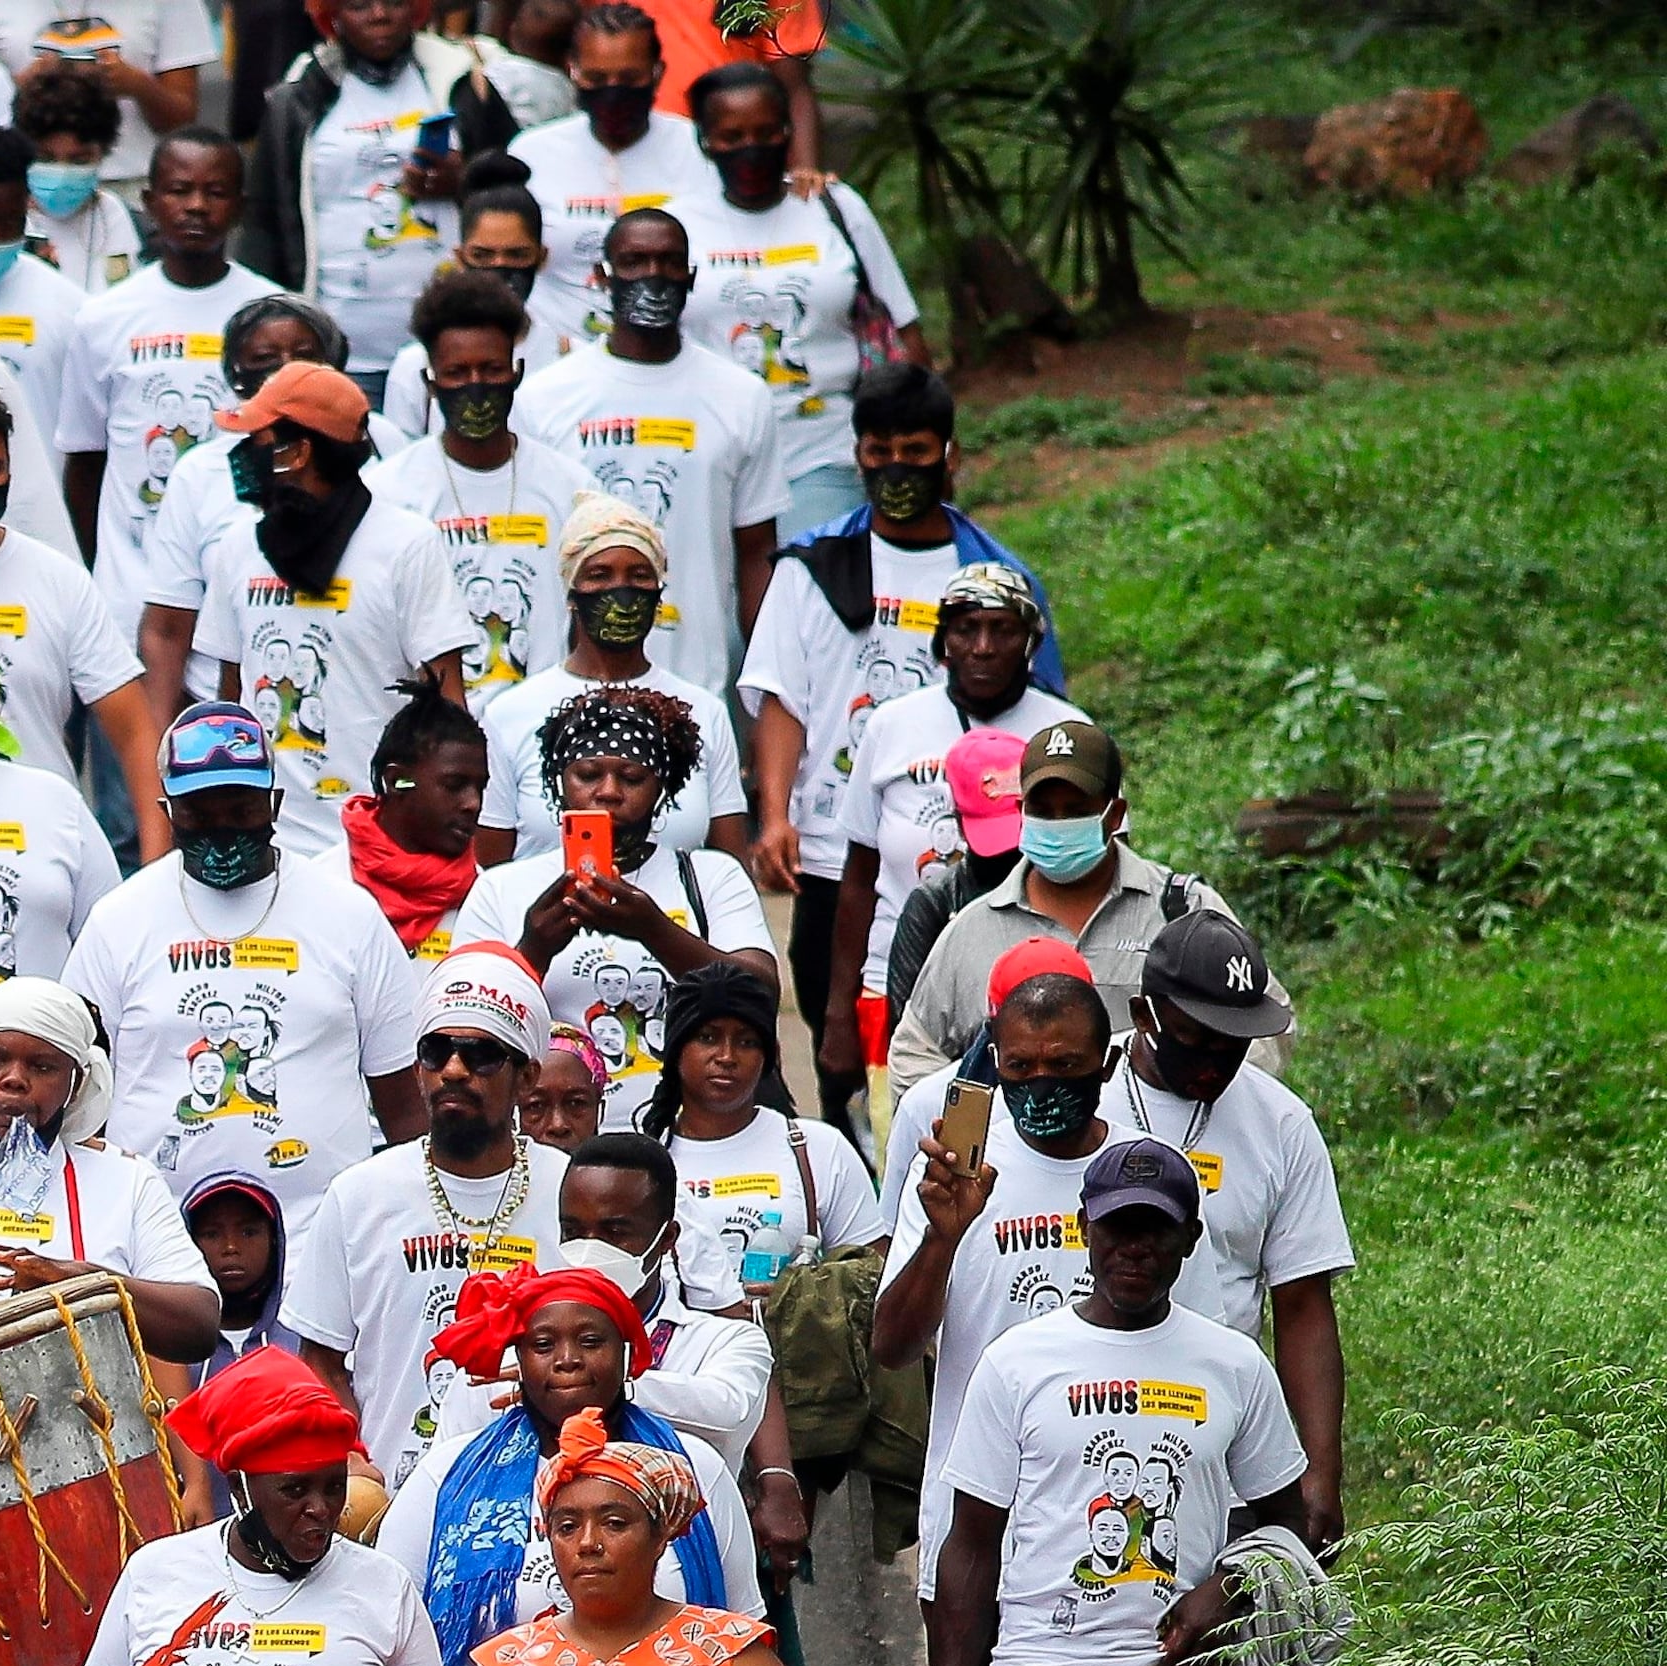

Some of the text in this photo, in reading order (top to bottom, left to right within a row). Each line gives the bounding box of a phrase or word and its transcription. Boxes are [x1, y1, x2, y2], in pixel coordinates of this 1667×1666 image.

[578, 418, 635, 446] VIVOS
[1046, 728, 1073, 756] LA
[168, 941, 232, 973] VIVOS
[1226, 955, 1254, 992] NY
[255, 982, 288, 1004] MILTON
[478, 985, 527, 1020] MAS
[994, 1214, 1063, 1256] VIVOS
[1067, 1380, 1137, 1417] VIVOS
[1151, 1442, 1186, 1469] MARTINEZ
[1162, 1431, 1194, 1458] MILTON
[193, 1623, 252, 1651] IVOS
[270, 1639, 310, 1647] QUEREMOS
[284, 1628, 321, 1637] LLEVARON
